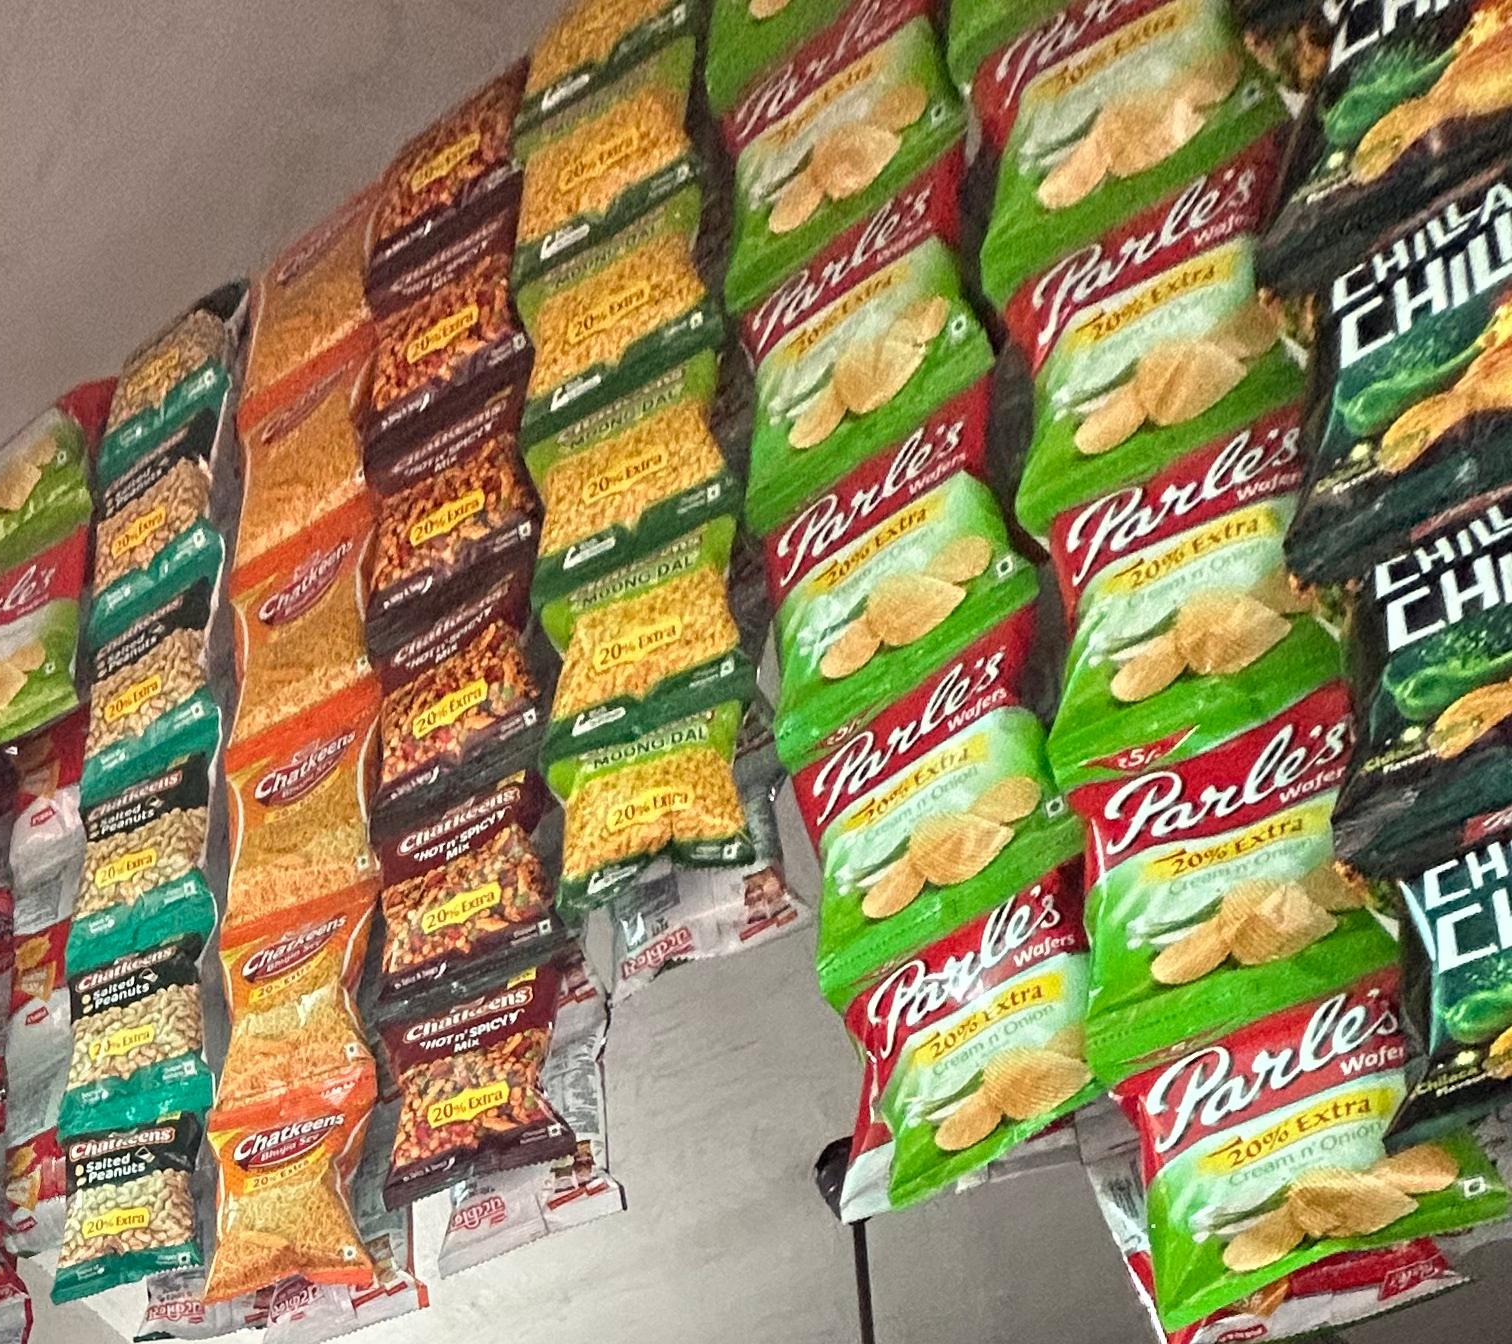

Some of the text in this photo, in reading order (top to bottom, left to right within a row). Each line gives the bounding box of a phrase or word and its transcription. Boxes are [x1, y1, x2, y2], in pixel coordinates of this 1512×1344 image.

[1033, 167, 1257, 346] Parle's
[625, 453, 663, 481] Extra
[908, 450, 966, 495] Wafers
[777, 419, 964, 588] Parle's
[1068, 423, 1299, 588] Parle's
[873, 507, 929, 550] Extra
[1193, 515, 1260, 554] Extra
[582, 555, 695, 607] MOONG DAL
[599, 622, 678, 667] 20% Extra
[946, 686, 1008, 735] Wafers
[592, 726, 708, 770] MOONG DAL
[814, 645, 1006, 827] Parle's
[254, 729, 357, 801] Chatkeens
[913, 744, 970, 791] Extra
[1104, 717, 1348, 856] Parle's
[99, 802, 142, 830] Salted
[100, 811, 156, 838] Peanuts
[397, 786, 522, 856] Chatkeens
[612, 803, 652, 830] 20%
[1171, 815, 1305, 877] 20% Extra
[425, 888, 496, 931] 20% Extra
[241, 912, 347, 976] Chatkeens
[1012, 932, 1075, 969] Wafers
[75, 947, 176, 993] Chatkeens
[92, 975, 137, 999] Salted
[867, 885, 1062, 1061] Parle's
[94, 982, 150, 1009] Peanuts
[402, 986, 533, 1047] Chatkeens
[929, 1009, 979, 1061] 20%
[931, 1003, 1057, 1079] Cream Onion
[1145, 988, 1401, 1155] Parle's
[1339, 1042, 1407, 1078] Wafer
[431, 1087, 504, 1124] 20% Extra
[68, 1125, 176, 1161] Chatkeens
[232, 1110, 346, 1165] Chatkeens
[260, 1141, 298, 1163] Bhujia
[1228, 1095, 1375, 1169] 20% Extra
[1228, 1149, 1295, 1188] Cream
[1318, 1119, 1386, 1153] Onion
[85, 1152, 131, 1174] Salted
[87, 1161, 146, 1185] Peanuts
[251, 1171, 280, 1189] 20%
[85, 1210, 146, 1235] 20% Extra
